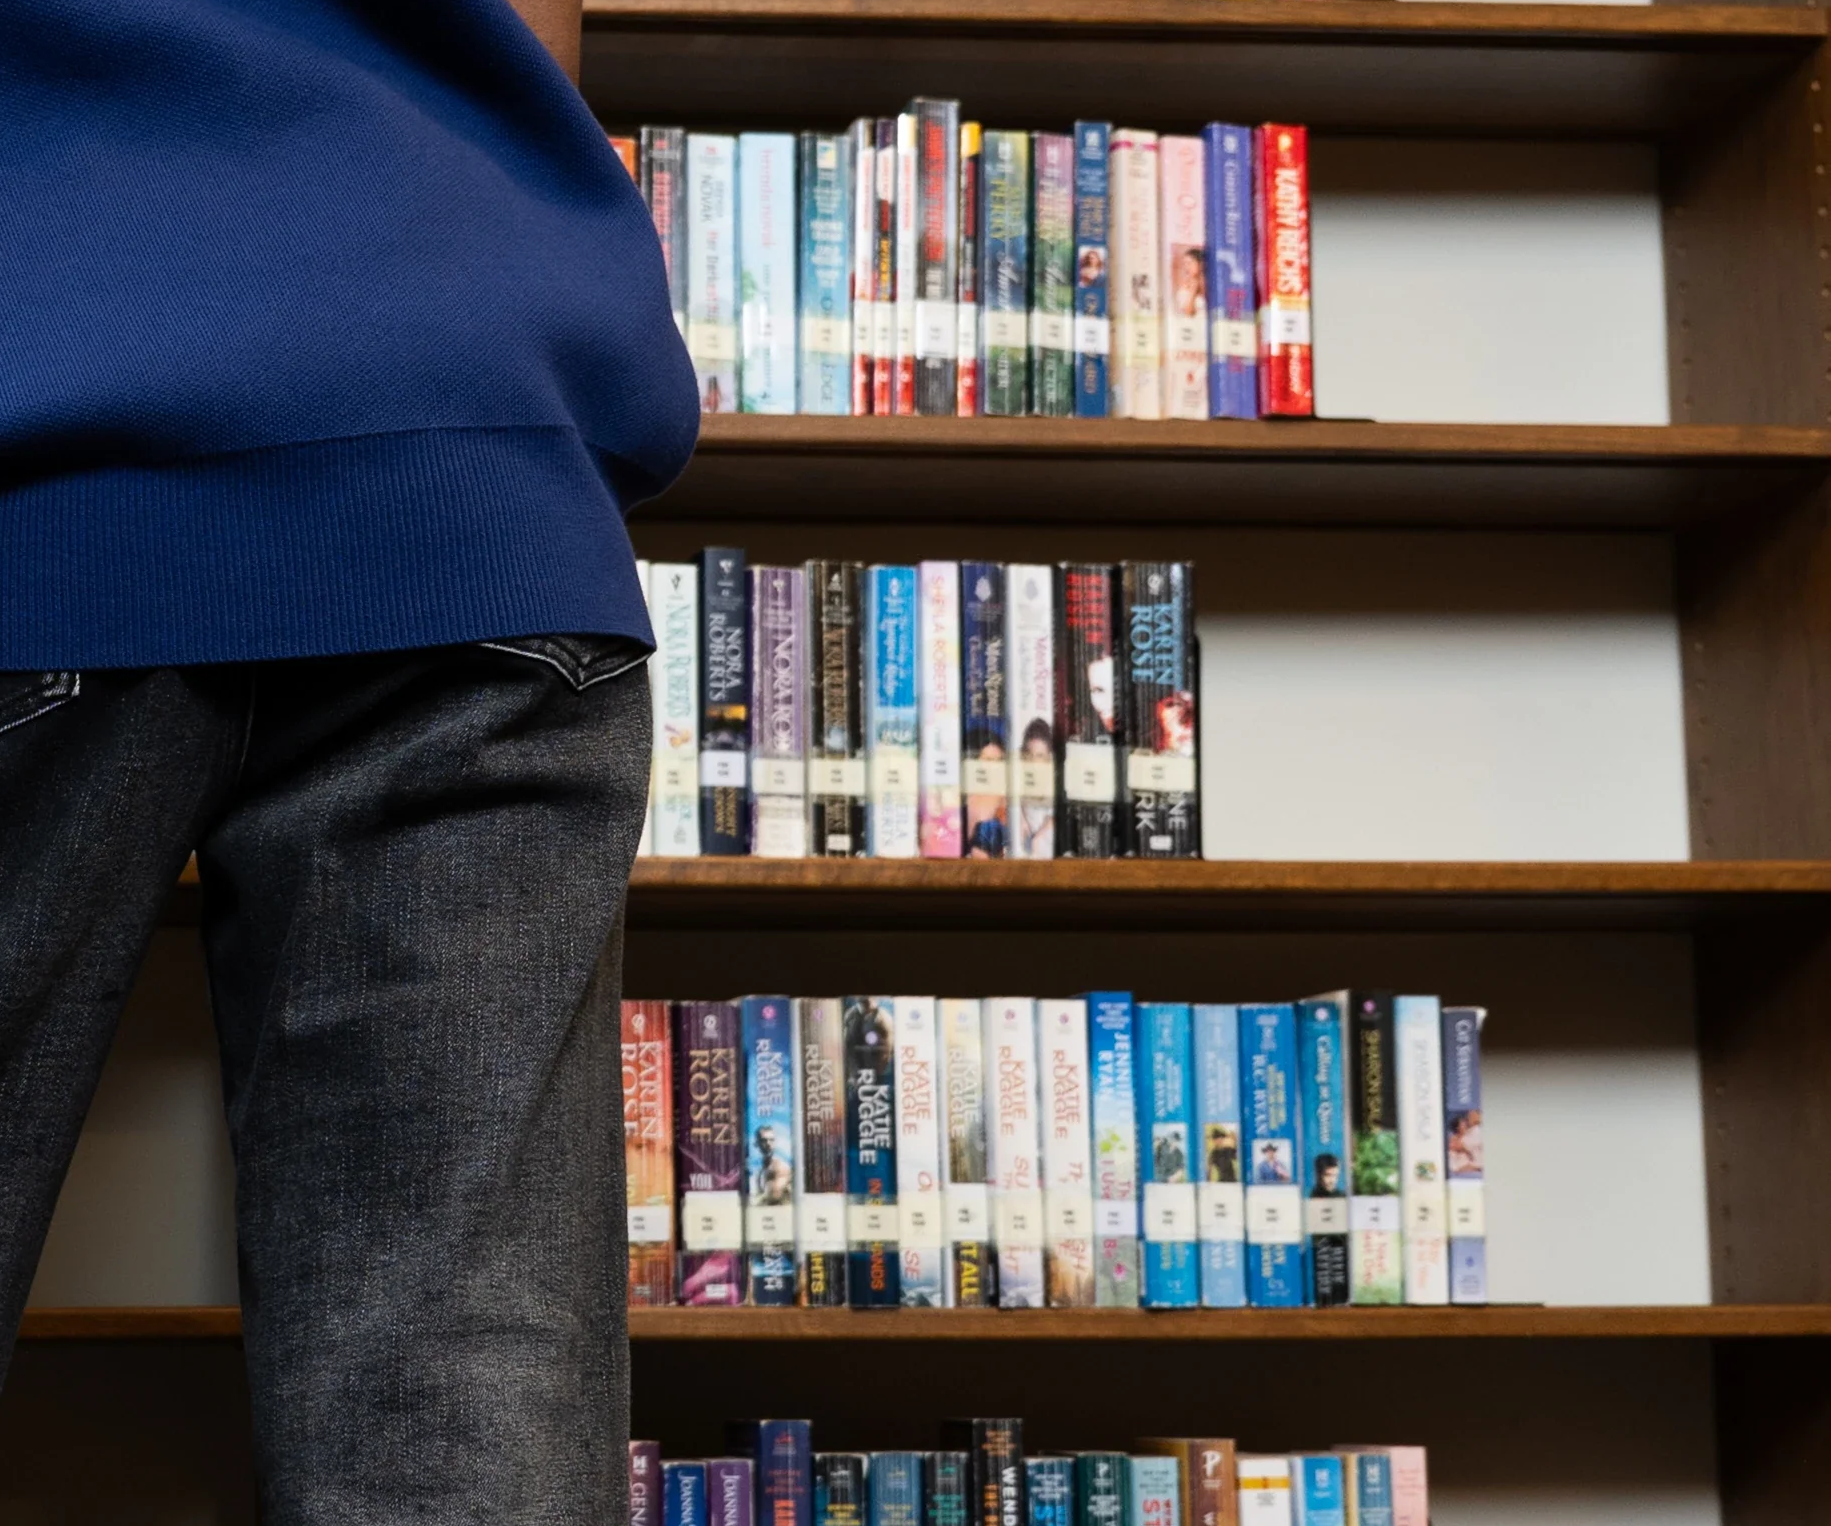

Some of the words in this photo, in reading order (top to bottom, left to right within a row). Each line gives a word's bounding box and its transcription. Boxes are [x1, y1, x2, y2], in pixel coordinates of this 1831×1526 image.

[700, 174, 713, 222] NOVAK
[1275, 167, 1303, 229] KATHY
[706, 230, 718, 252] Her
[1276, 229, 1303, 294] REICHS
[705, 255, 719, 301] Darkest
[821, 363, 835, 404] EDGE
[932, 575, 946, 633] SHEILA
[708, 612, 725, 702] ROBERTS
[725, 625, 743, 688] NORA
[772, 634, 795, 702] NORA
[933, 639, 947, 712] ROBERTS
[1130, 604, 1151, 685] ROSE
[1155, 603, 1175, 686] KAREN
[689, 1048, 712, 1145] ROSE
[713, 1047, 730, 1145] KAREN
[857, 1068, 876, 1166] RUGGLE
[873, 1083, 892, 1150] KATIE
[901, 1045, 917, 1137] RUGGLE
[916, 1060, 932, 1121] KATIE
